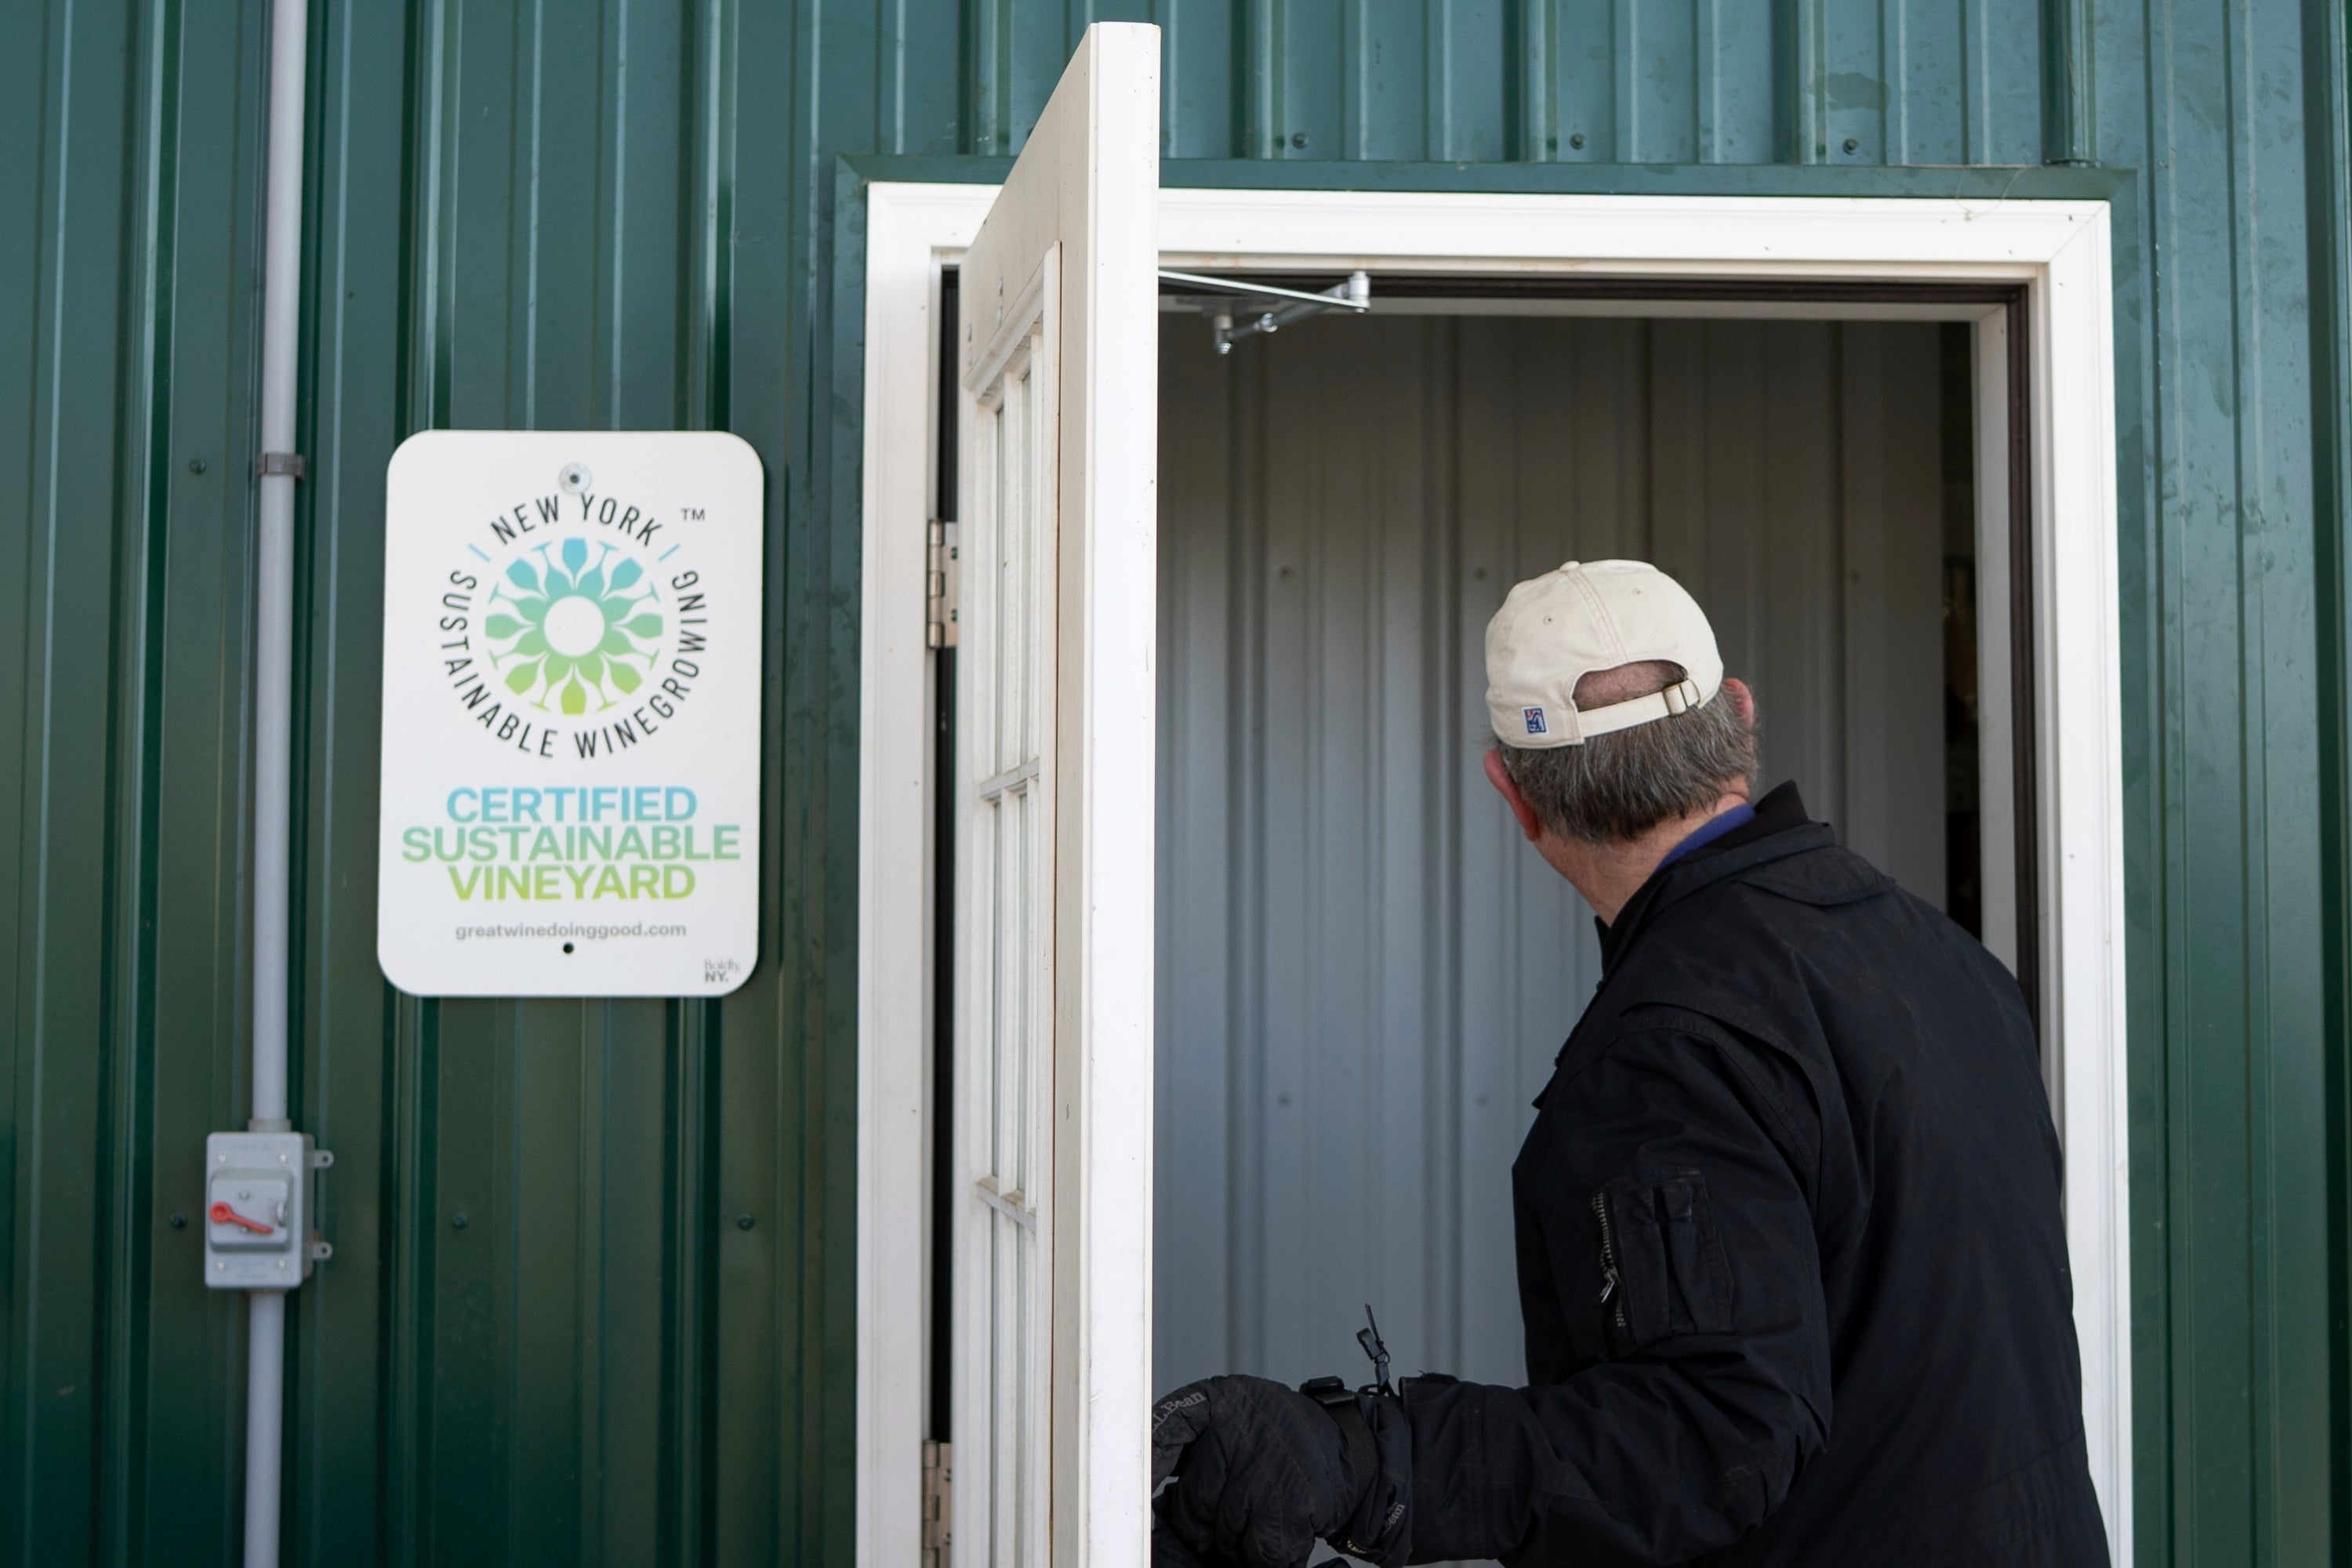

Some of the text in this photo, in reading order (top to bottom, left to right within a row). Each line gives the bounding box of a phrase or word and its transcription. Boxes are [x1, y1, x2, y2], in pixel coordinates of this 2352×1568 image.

[490, 492, 662, 546] NEW YORK
[681, 508, 706, 521] TM
[440, 570, 708, 759] SUSTAINABLE WINEGROWING
[446, 786, 698, 823] CERTIFIED
[401, 824, 741, 862] SUSTAINABLE
[447, 863, 696, 901] VINEYARD
[456, 922, 687, 940] greatwinedoinggood.com
